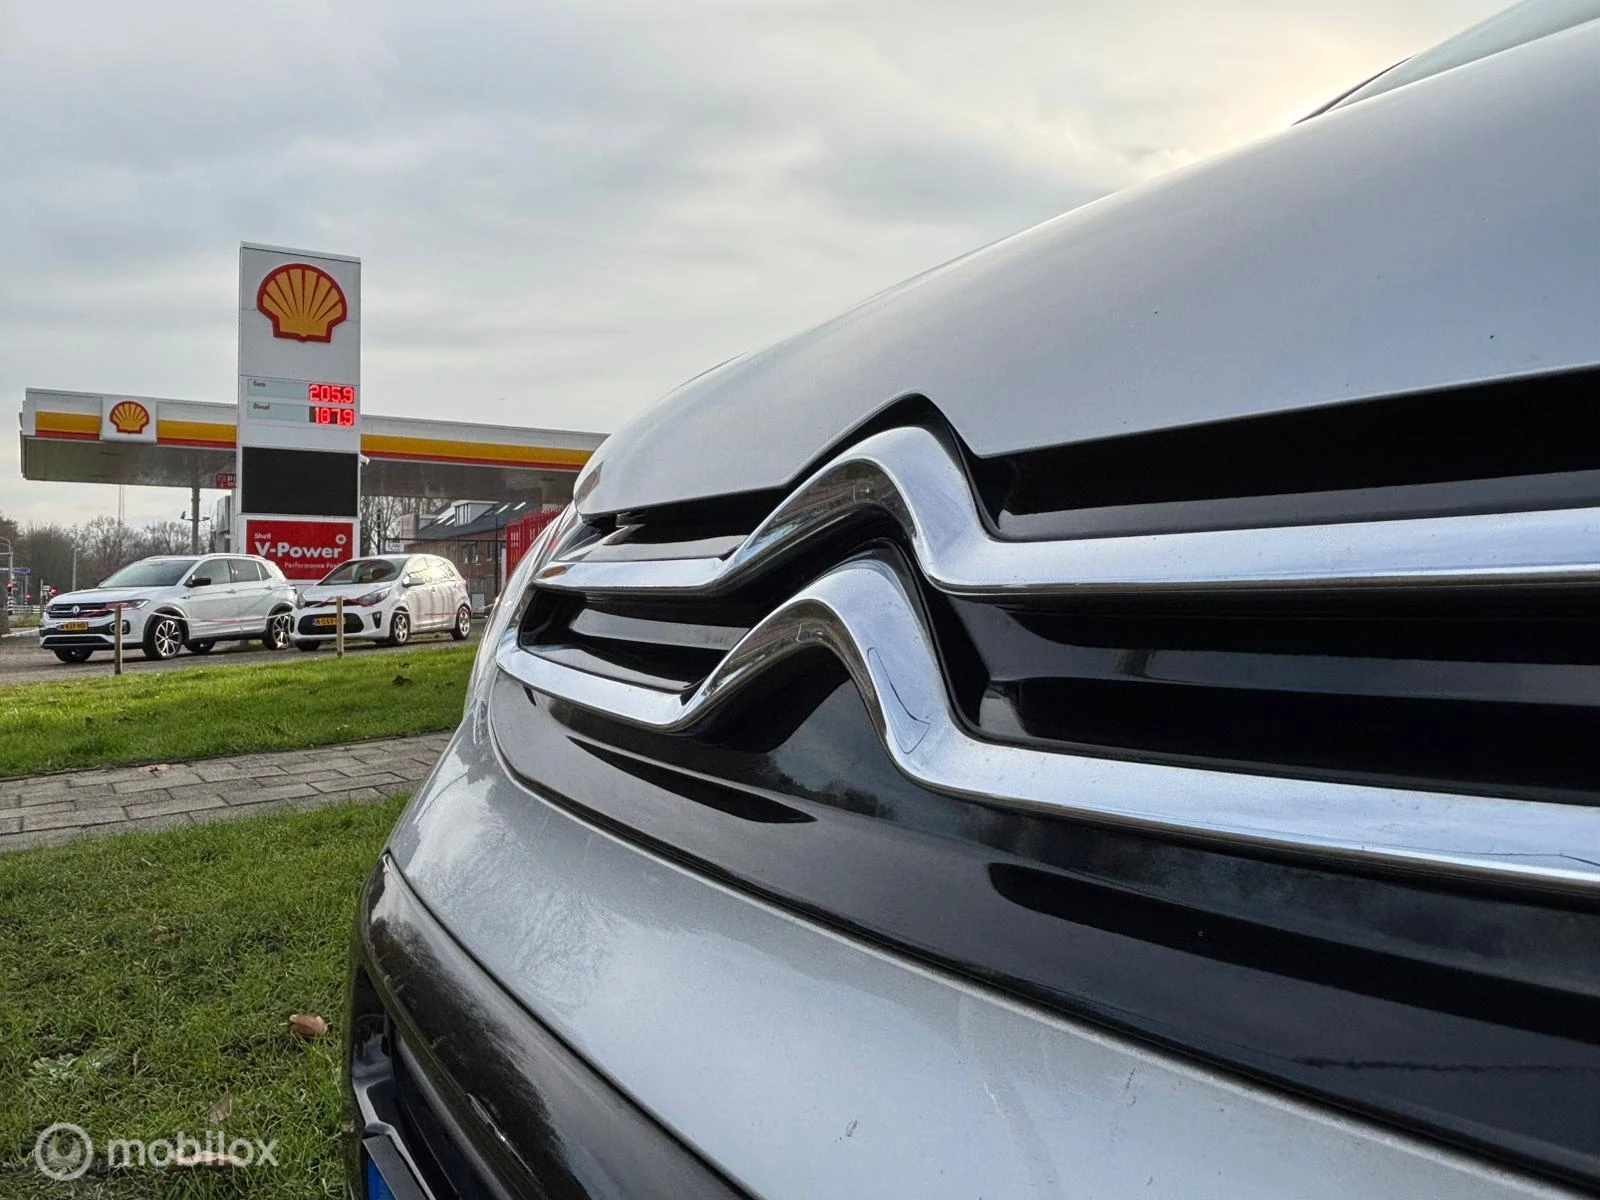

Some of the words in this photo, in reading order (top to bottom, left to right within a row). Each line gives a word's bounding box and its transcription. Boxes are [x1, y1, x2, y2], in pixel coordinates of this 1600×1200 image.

[254, 532, 271, 540] Shell
[254, 541, 342, 558] V-Power
[284, 561, 325, 569] Performance
